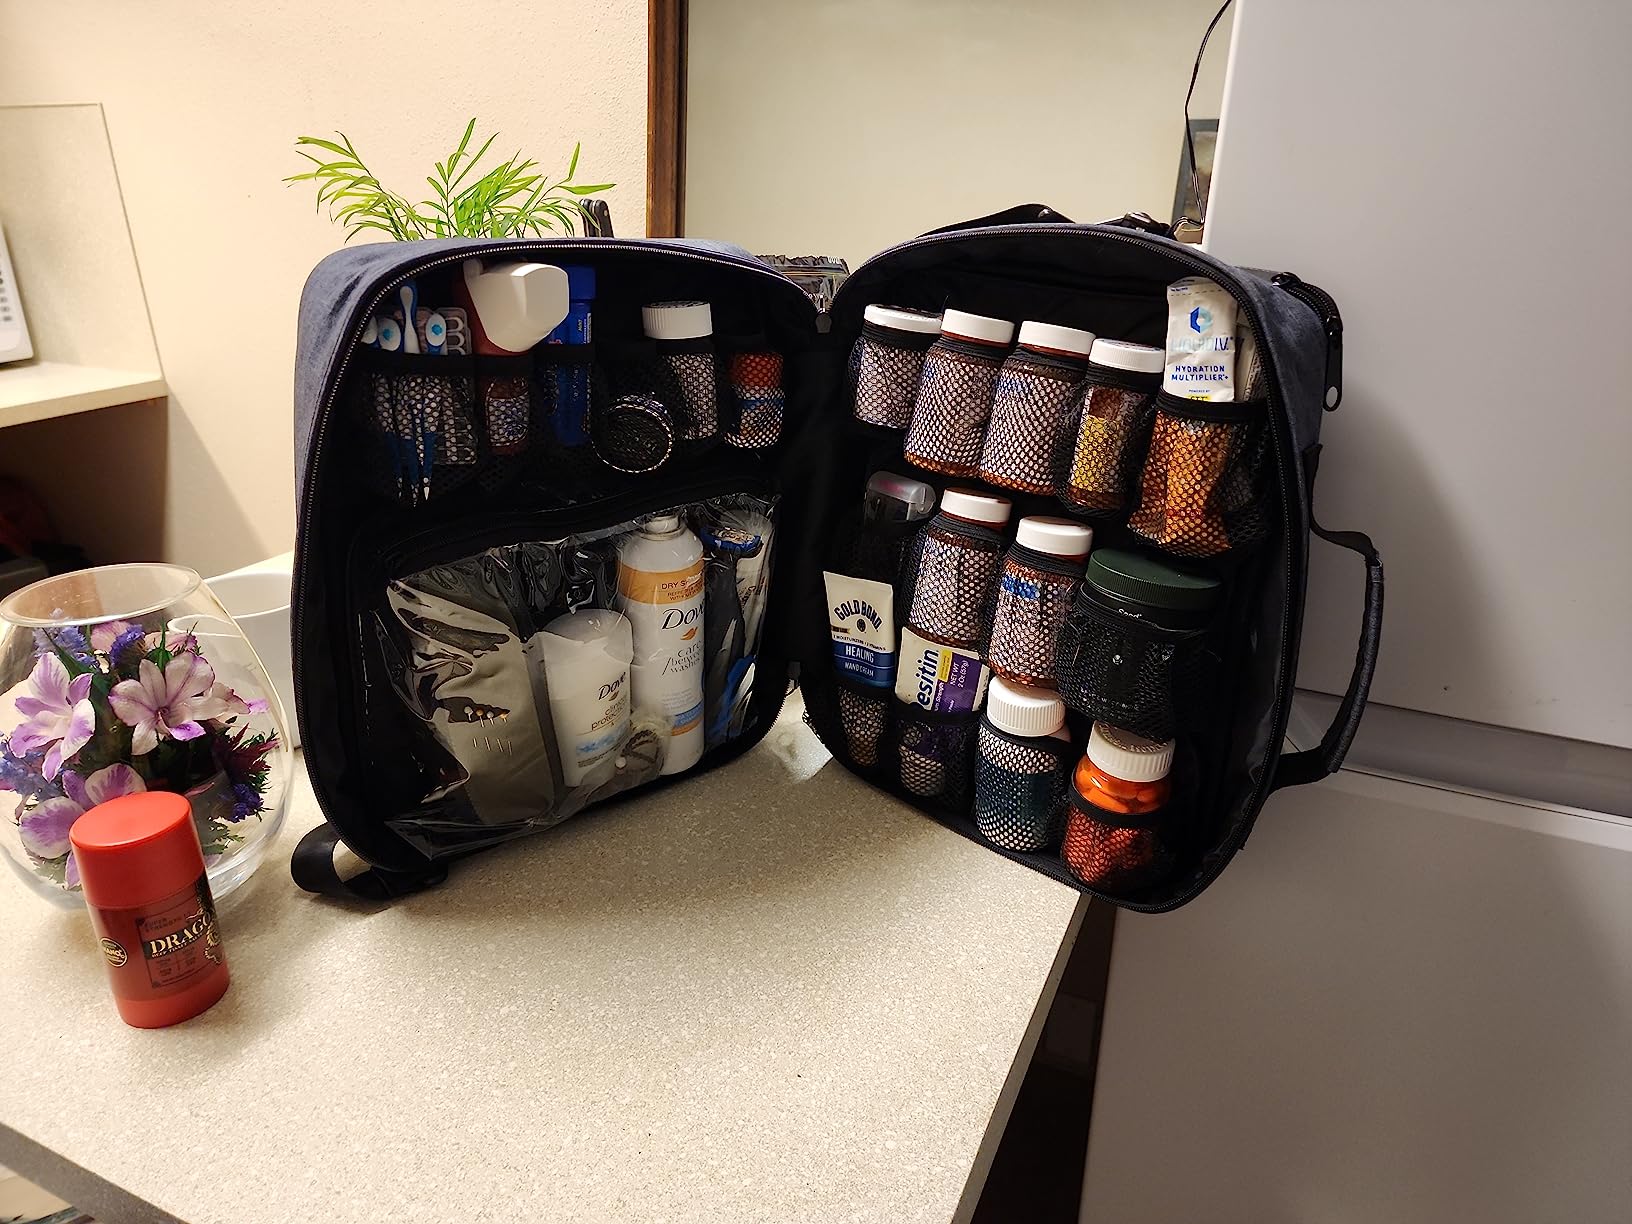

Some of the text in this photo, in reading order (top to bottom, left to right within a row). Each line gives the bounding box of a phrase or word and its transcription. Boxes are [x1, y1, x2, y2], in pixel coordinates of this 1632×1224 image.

[1175, 365, 1225, 373] HYDRATION
[661, 581, 679, 590] DRY
[833, 599, 883, 630] GOLD BOND
[845, 645, 875, 664] HEALING
[844, 661, 875, 678] HAND CREAM
[916, 649, 939, 707] esitin
[950, 661, 960, 686] NET WT
